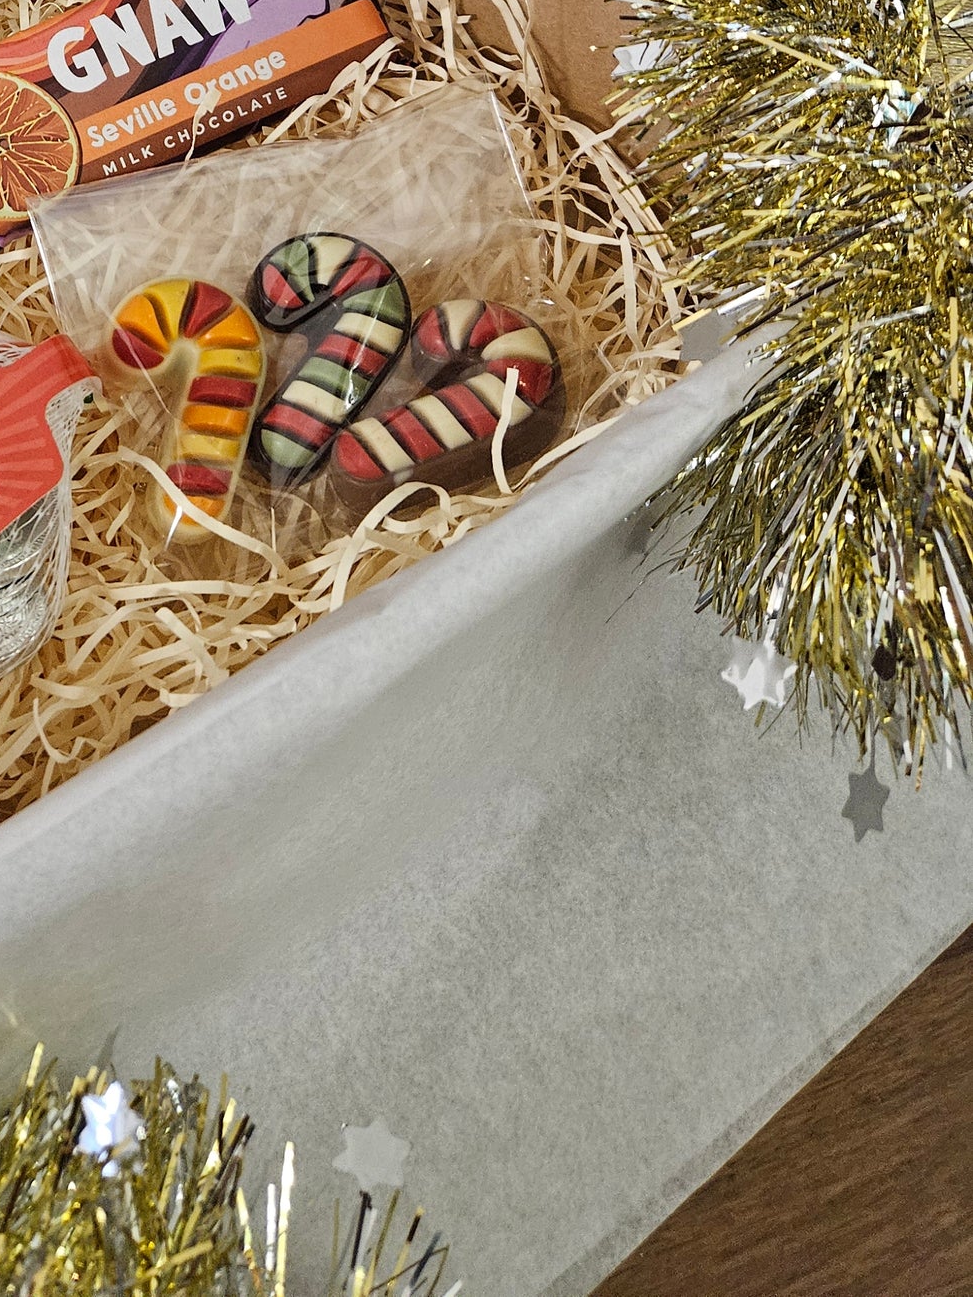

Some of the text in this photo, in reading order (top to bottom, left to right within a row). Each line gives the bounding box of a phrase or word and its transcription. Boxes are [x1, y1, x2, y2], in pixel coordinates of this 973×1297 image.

[85, 98, 178, 150] Seville
[101, 86, 289, 177] MILK CHOCOLATE
